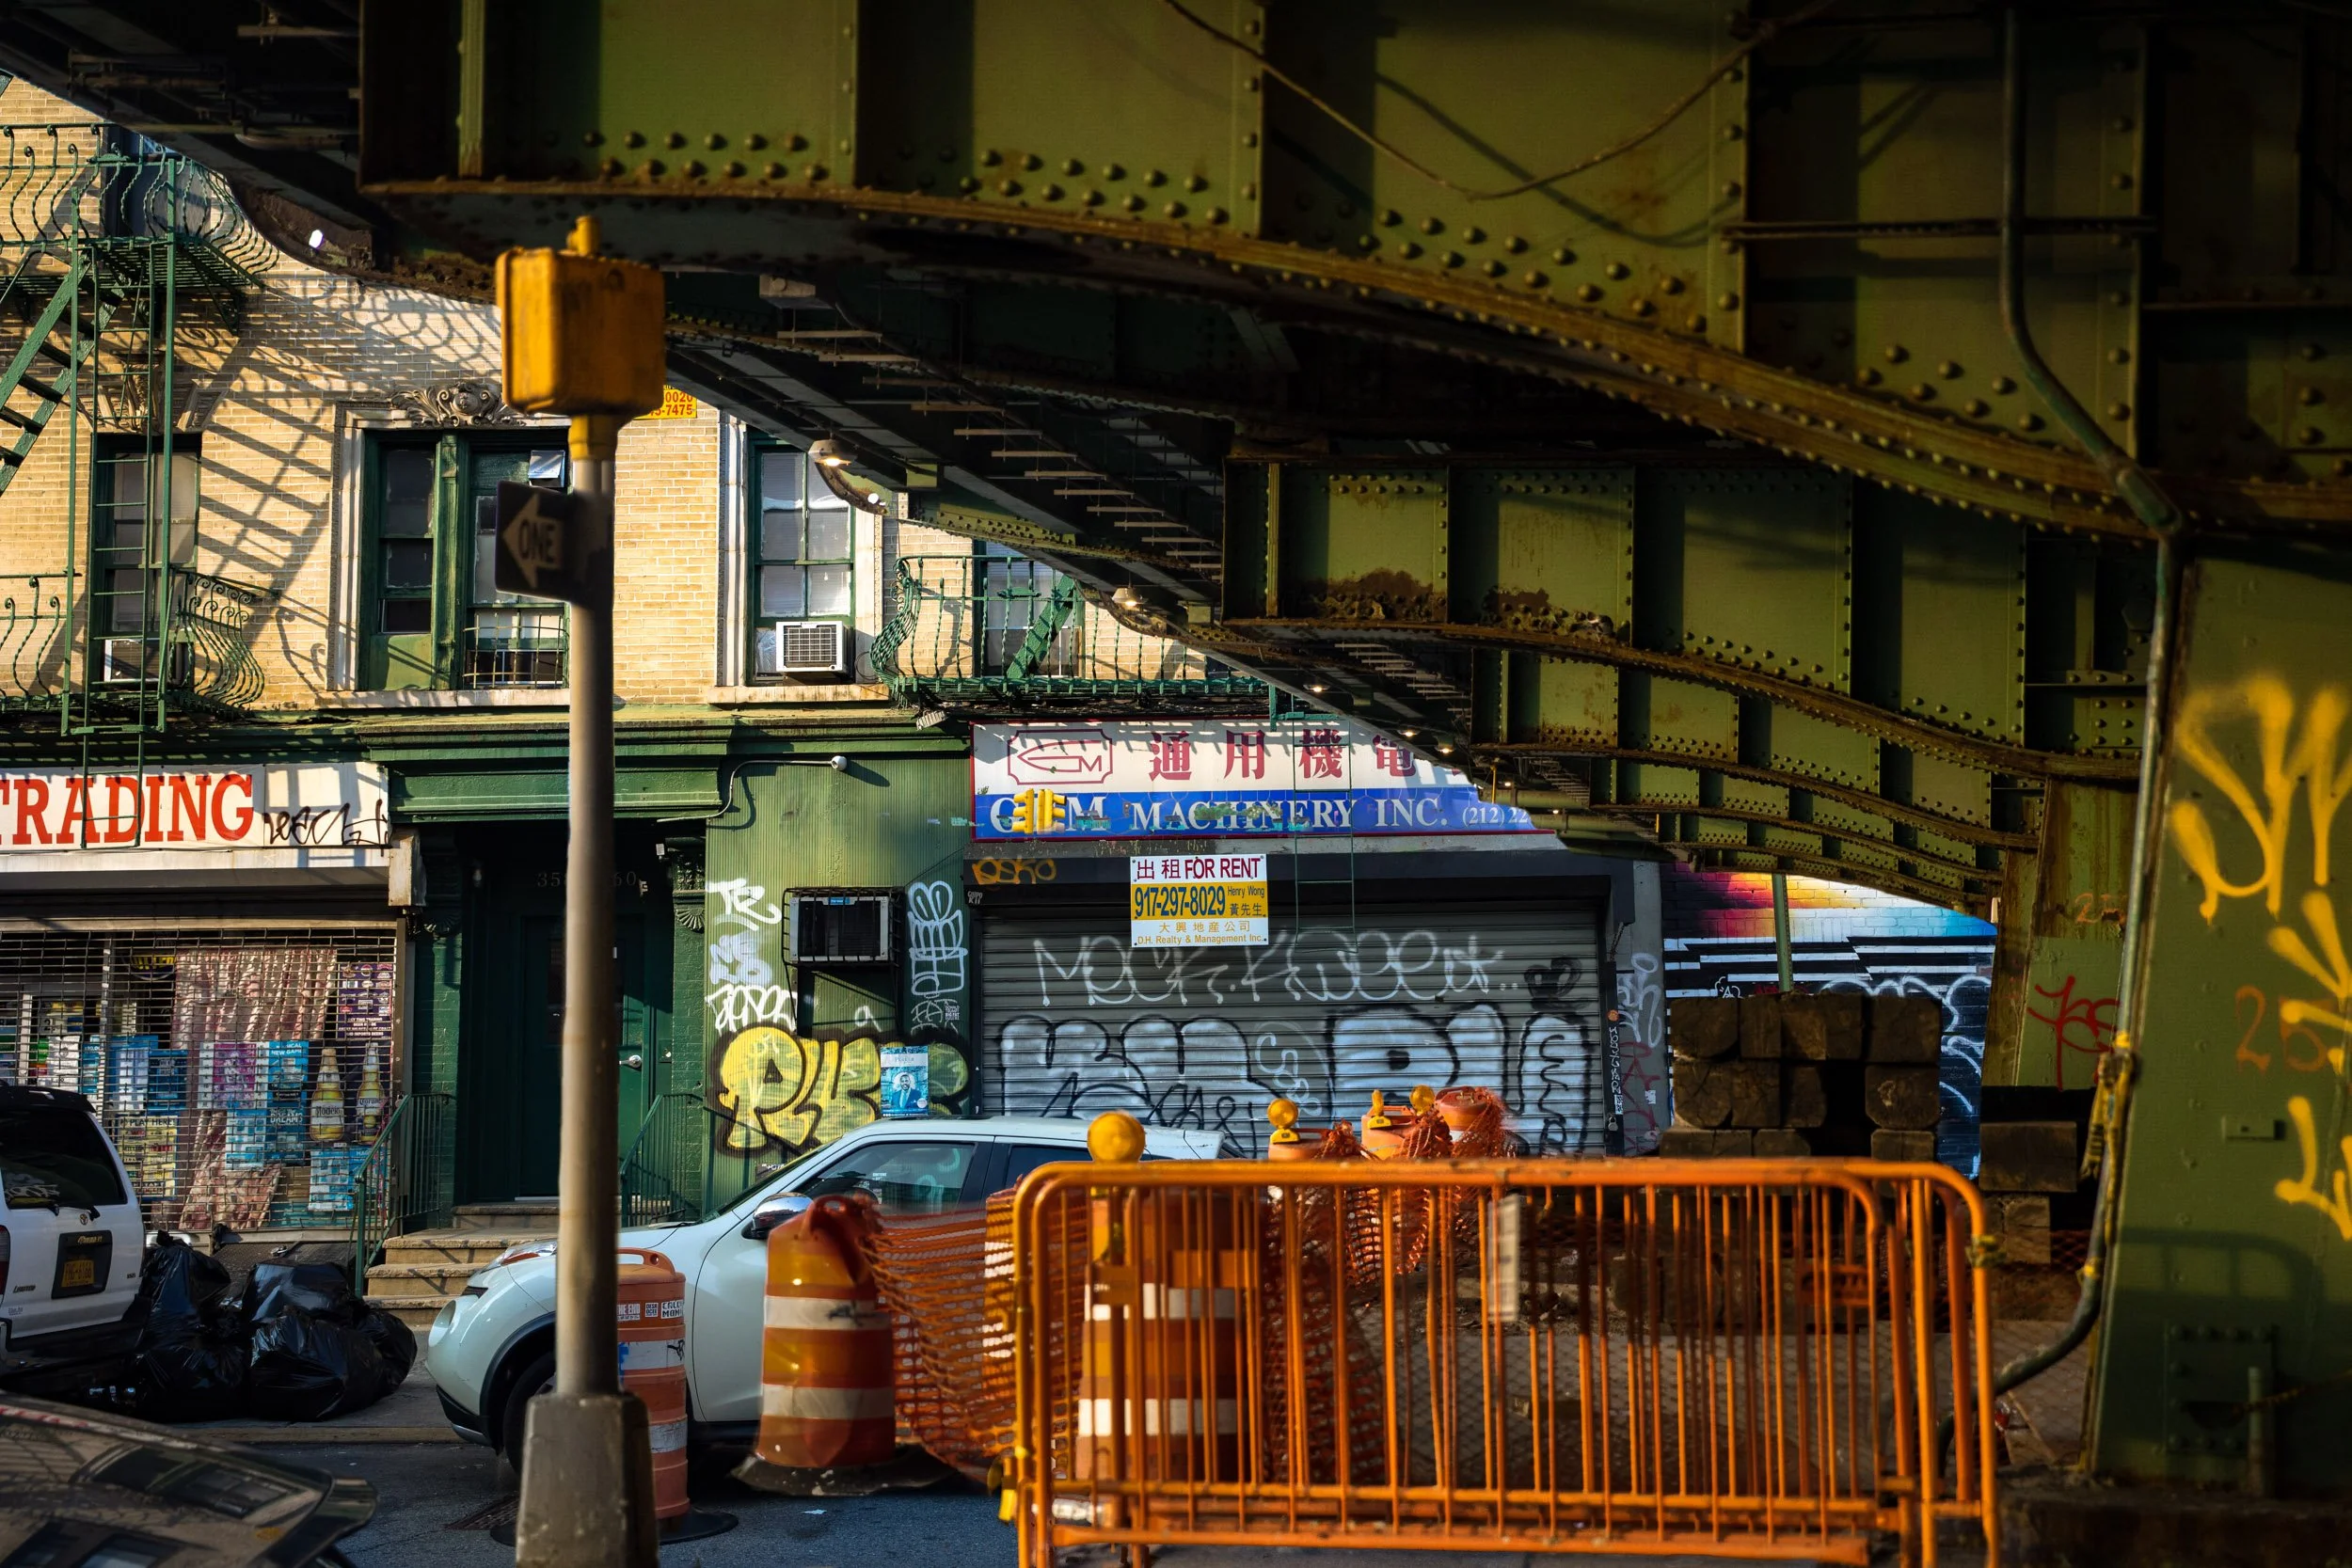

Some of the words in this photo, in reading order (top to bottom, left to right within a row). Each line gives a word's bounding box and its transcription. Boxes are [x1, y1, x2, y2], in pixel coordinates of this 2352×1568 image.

[518, 519, 555, 563] ONE
[990, 796, 1108, 832] GM
[1133, 799, 1358, 830] MACHINERY
[1375, 798, 1448, 828] INC.
[1462, 806, 1505, 828] (212)
[1136, 859, 1182, 880] 出租
[1184, 858, 1216, 879] FOR
[1219, 857, 1262, 879] RENT
[1135, 885, 1226, 917] 917-297-8029
[1227, 885, 1246, 898] Henry
[1248, 885, 1265, 898] Wong
[1137, 936, 1153, 944] D.H.
[1155, 935, 1183, 945] Realty
[1185, 935, 1191, 943] &
[1194, 934, 1247, 944] Management
[1249, 934, 1263, 942] Inc.
